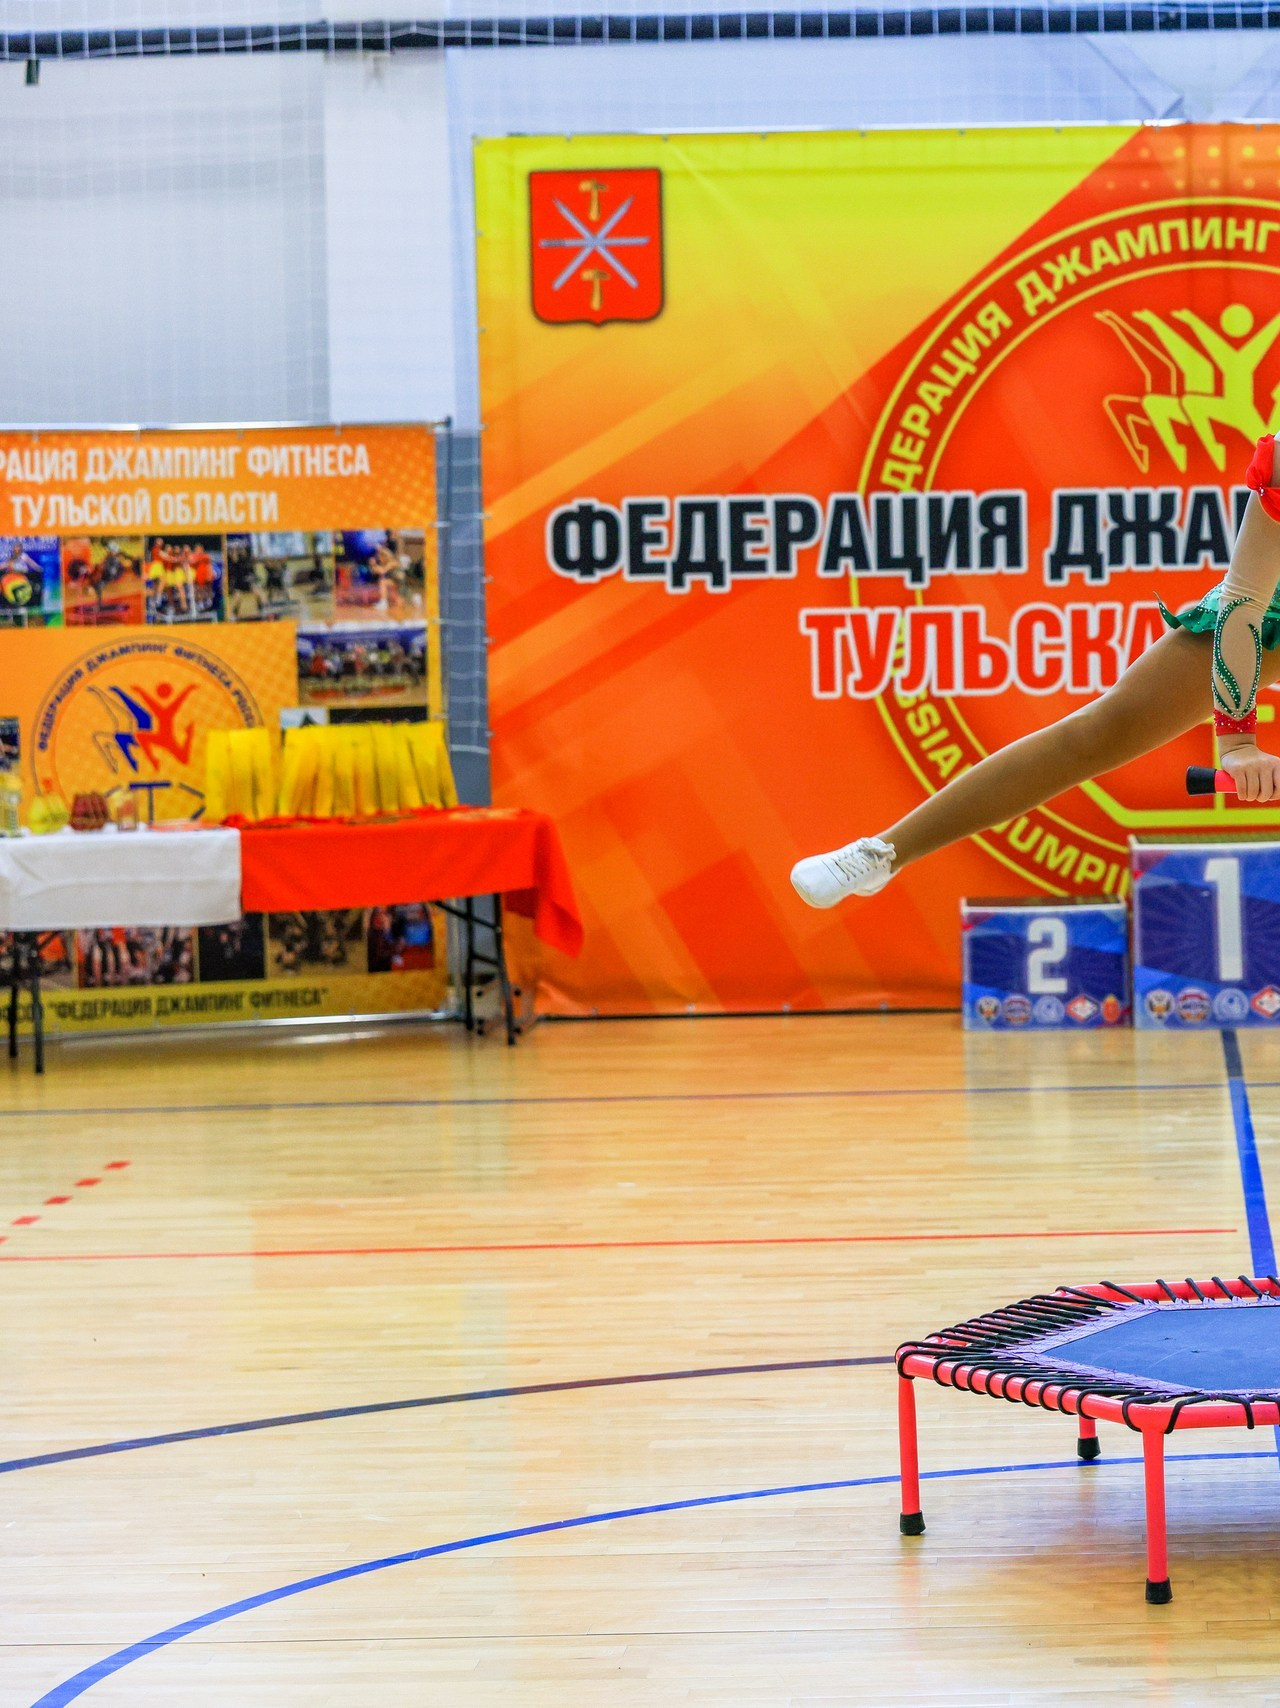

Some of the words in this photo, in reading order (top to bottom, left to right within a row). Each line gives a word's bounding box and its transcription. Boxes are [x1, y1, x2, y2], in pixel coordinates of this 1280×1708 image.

[880, 300, 1014, 493] ДЕРАЦИЯ
[11, 487, 153, 528] ТУЛЬСКОЙ
[158, 491, 280, 524] ОБЛАСТИ
[84, 445, 243, 483] ДЖАМПИНГ
[247, 443, 372, 477] ФИТНЕСА
[548, 490, 1027, 592] ФЕДЕРАЦИЯ
[1026, 917, 1068, 994] 2
[1204, 857, 1244, 981] 1
